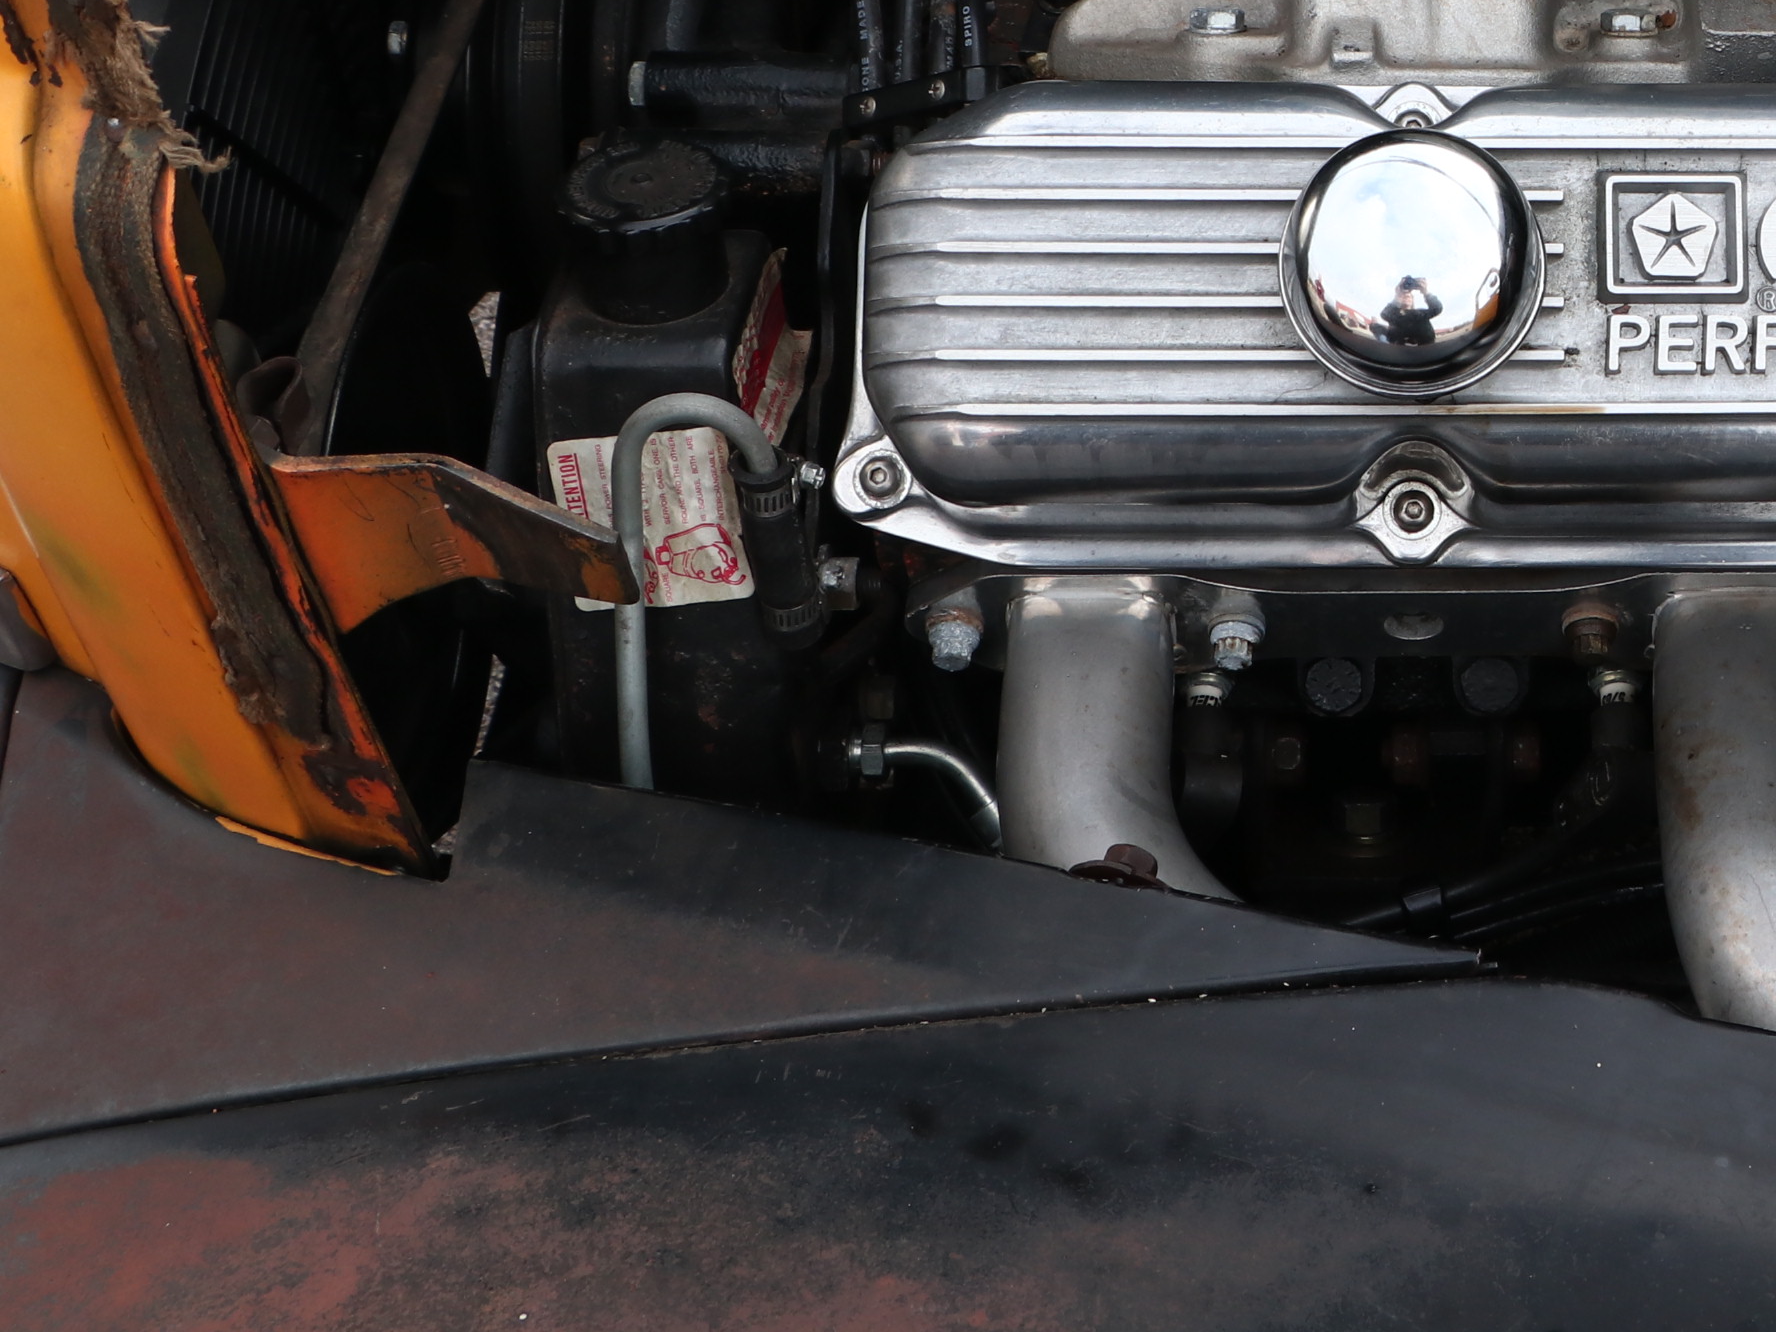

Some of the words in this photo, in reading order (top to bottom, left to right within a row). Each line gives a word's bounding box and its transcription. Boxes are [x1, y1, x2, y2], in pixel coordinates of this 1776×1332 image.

[857, 0, 870, 41] MADE
[962, 4, 973, 47] SPIRO
[650, 438, 657, 446] IS
[667, 436, 678, 462] OTHER
[686, 436, 694, 451] ARE
[595, 444, 608, 480] STEERING
[652, 449, 661, 466] ONE
[689, 455, 699, 475] BOTH
[673, 464, 681, 478] THE
[557, 454, 585, 518] TENTION
[674, 480, 683, 496] AND
[662, 573, 673, 603] SQUARE
